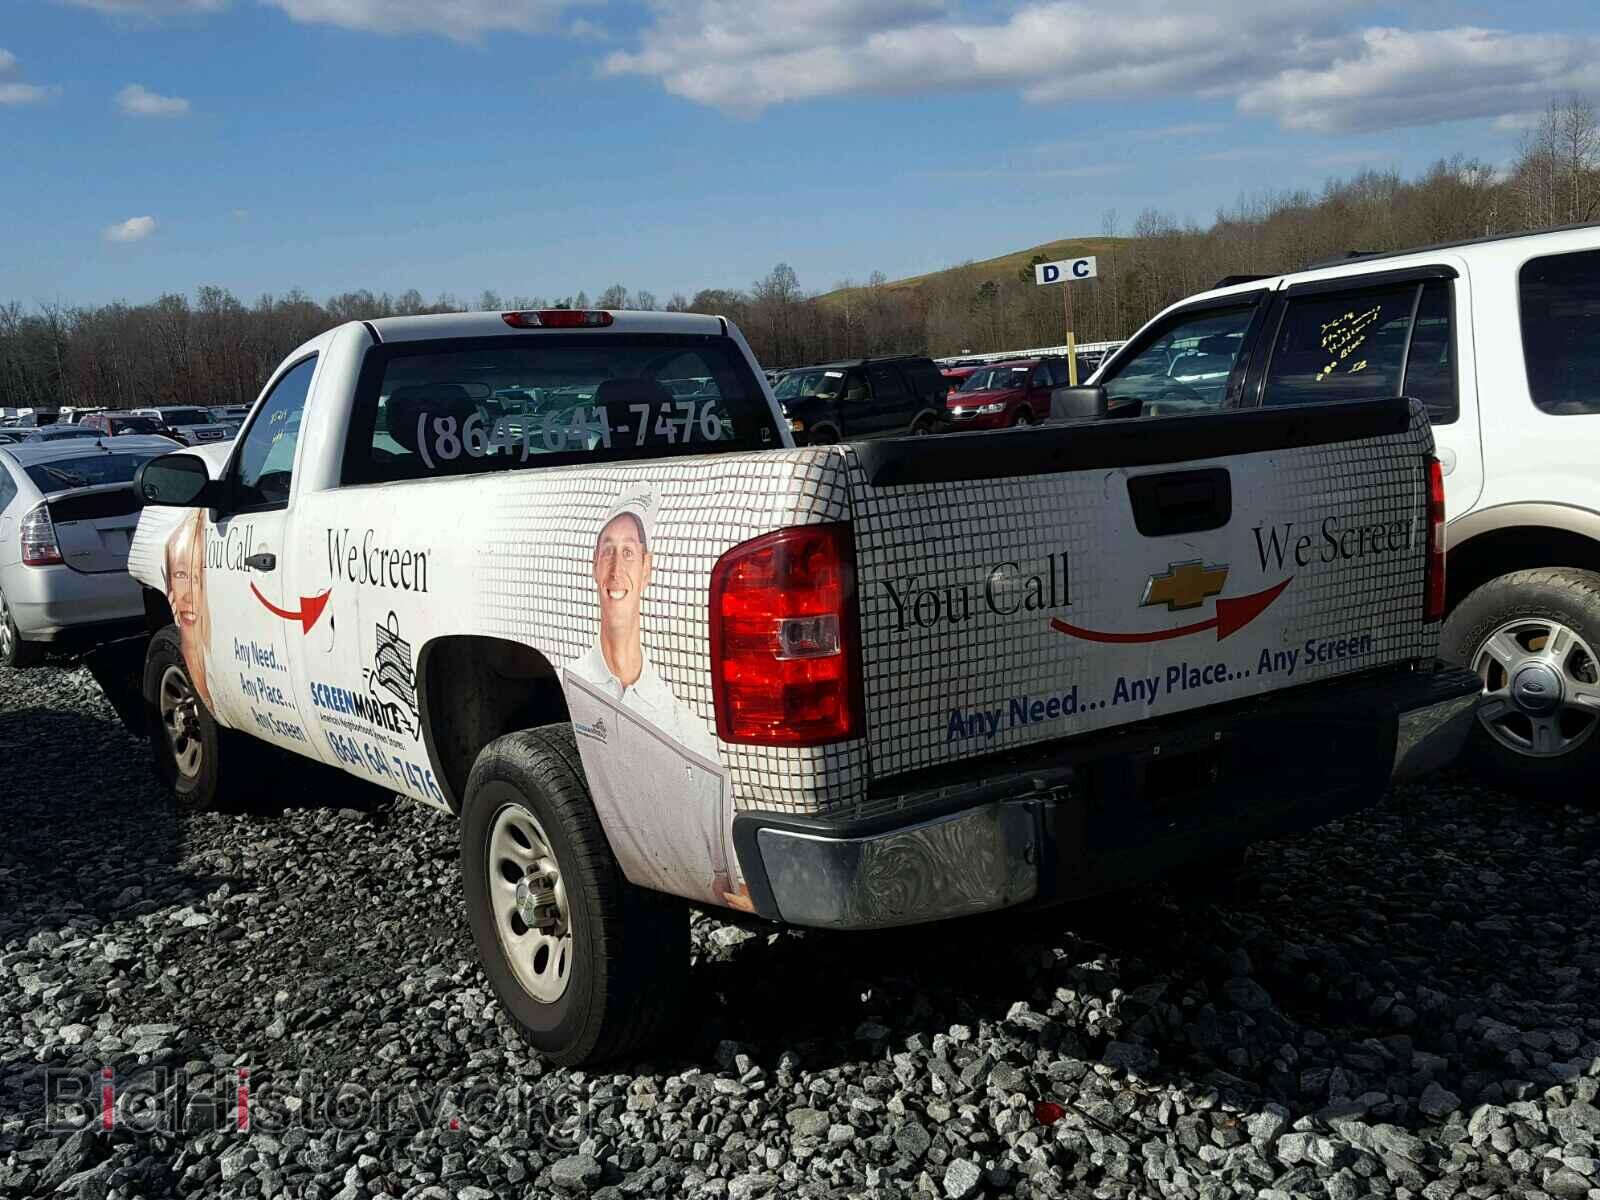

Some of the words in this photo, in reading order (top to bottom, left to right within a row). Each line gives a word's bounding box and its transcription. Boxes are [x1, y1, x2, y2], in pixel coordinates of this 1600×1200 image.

[1043, 265, 1059, 282] D
[1072, 260, 1089, 277] C
[417, 412, 529, 469] (864)
[543, 400, 722, 451] 641-7476
[203, 528, 224, 569] You
[226, 524, 253, 572] Call
[327, 528, 357, 583] We
[359, 528, 428, 592] Screen
[1252, 522, 1312, 573] We
[880, 576, 971, 633] You
[985, 551, 1073, 616] Call
[234, 636, 250, 669] Any
[240, 672, 259, 704] Any
[310, 681, 403, 734] SCREENMOBILE
[948, 708, 1001, 739] Any
[1009, 685, 1106, 727] Need...
[1112, 677, 1159, 705] Any
[1166, 662, 1250, 693] Place...
[1257, 648, 1300, 676] Any
[1304, 634, 1372, 665] Screen
